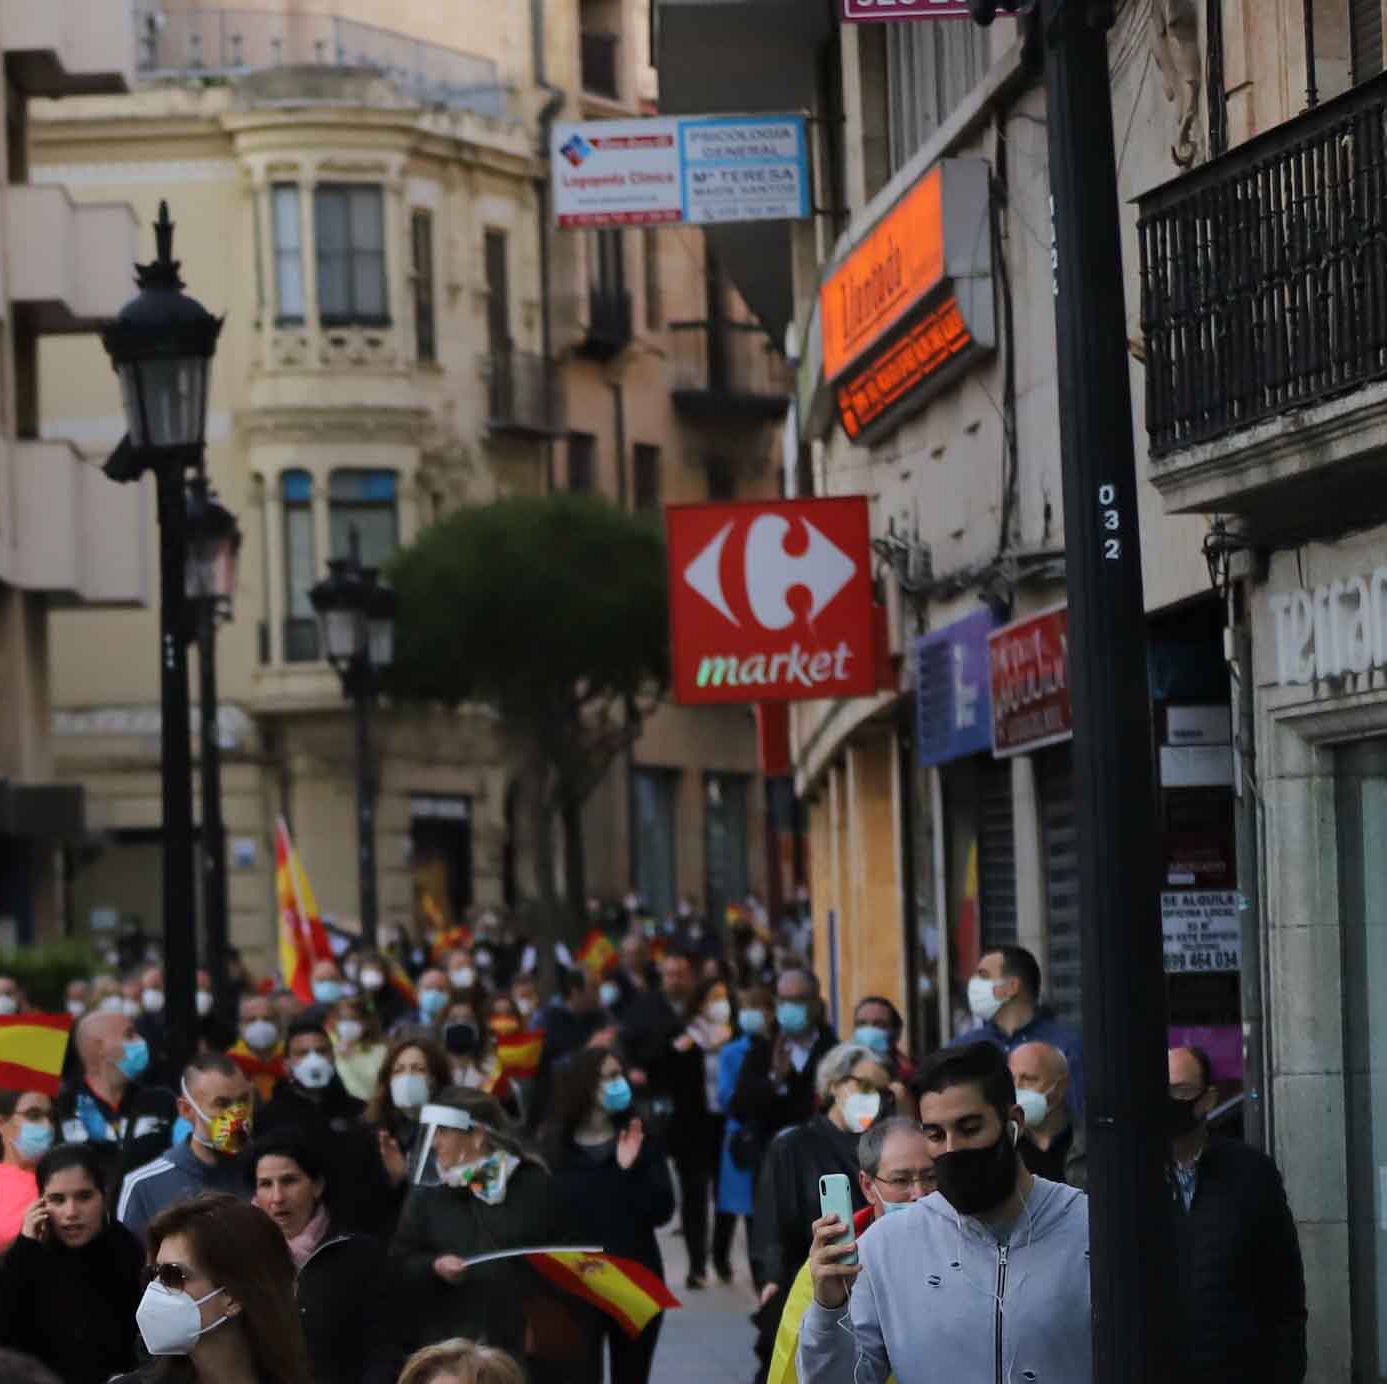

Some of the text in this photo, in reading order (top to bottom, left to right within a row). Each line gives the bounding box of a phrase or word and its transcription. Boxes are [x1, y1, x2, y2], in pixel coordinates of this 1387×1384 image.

[702, 143, 778, 159] GENERAL
[720, 167, 794, 183] TERESA
[1098, 483, 1121, 560] 032
[695, 639, 853, 689] market
[1182, 894, 1235, 907] ALQUILA
